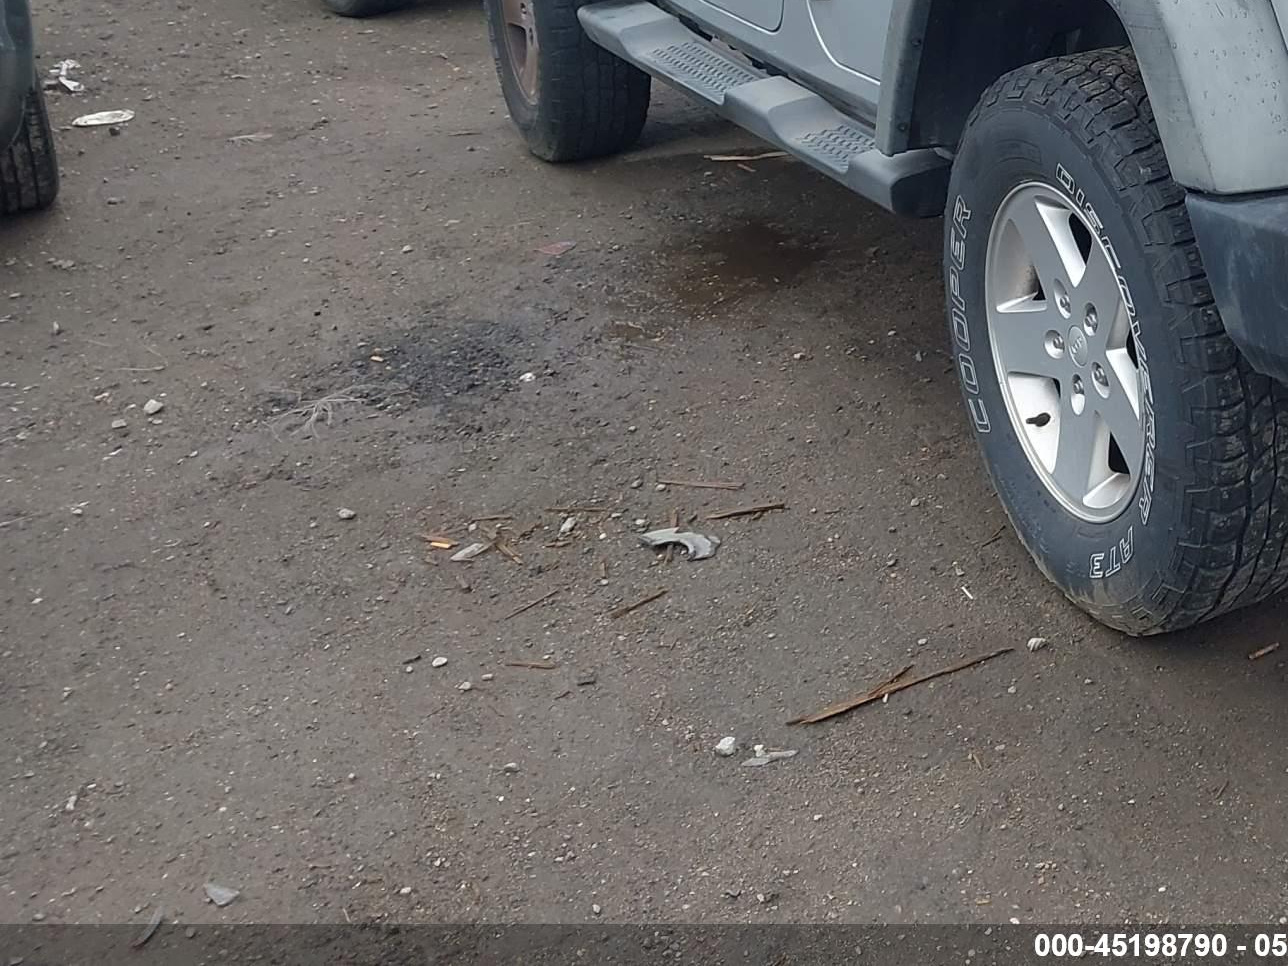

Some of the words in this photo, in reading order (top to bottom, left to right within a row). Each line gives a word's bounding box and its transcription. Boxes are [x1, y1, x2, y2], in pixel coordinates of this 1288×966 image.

[954, 195, 992, 433] COOPER
[1056, 163, 1156, 525] DISCOVERER
[1089, 525, 1134, 578] AT3
